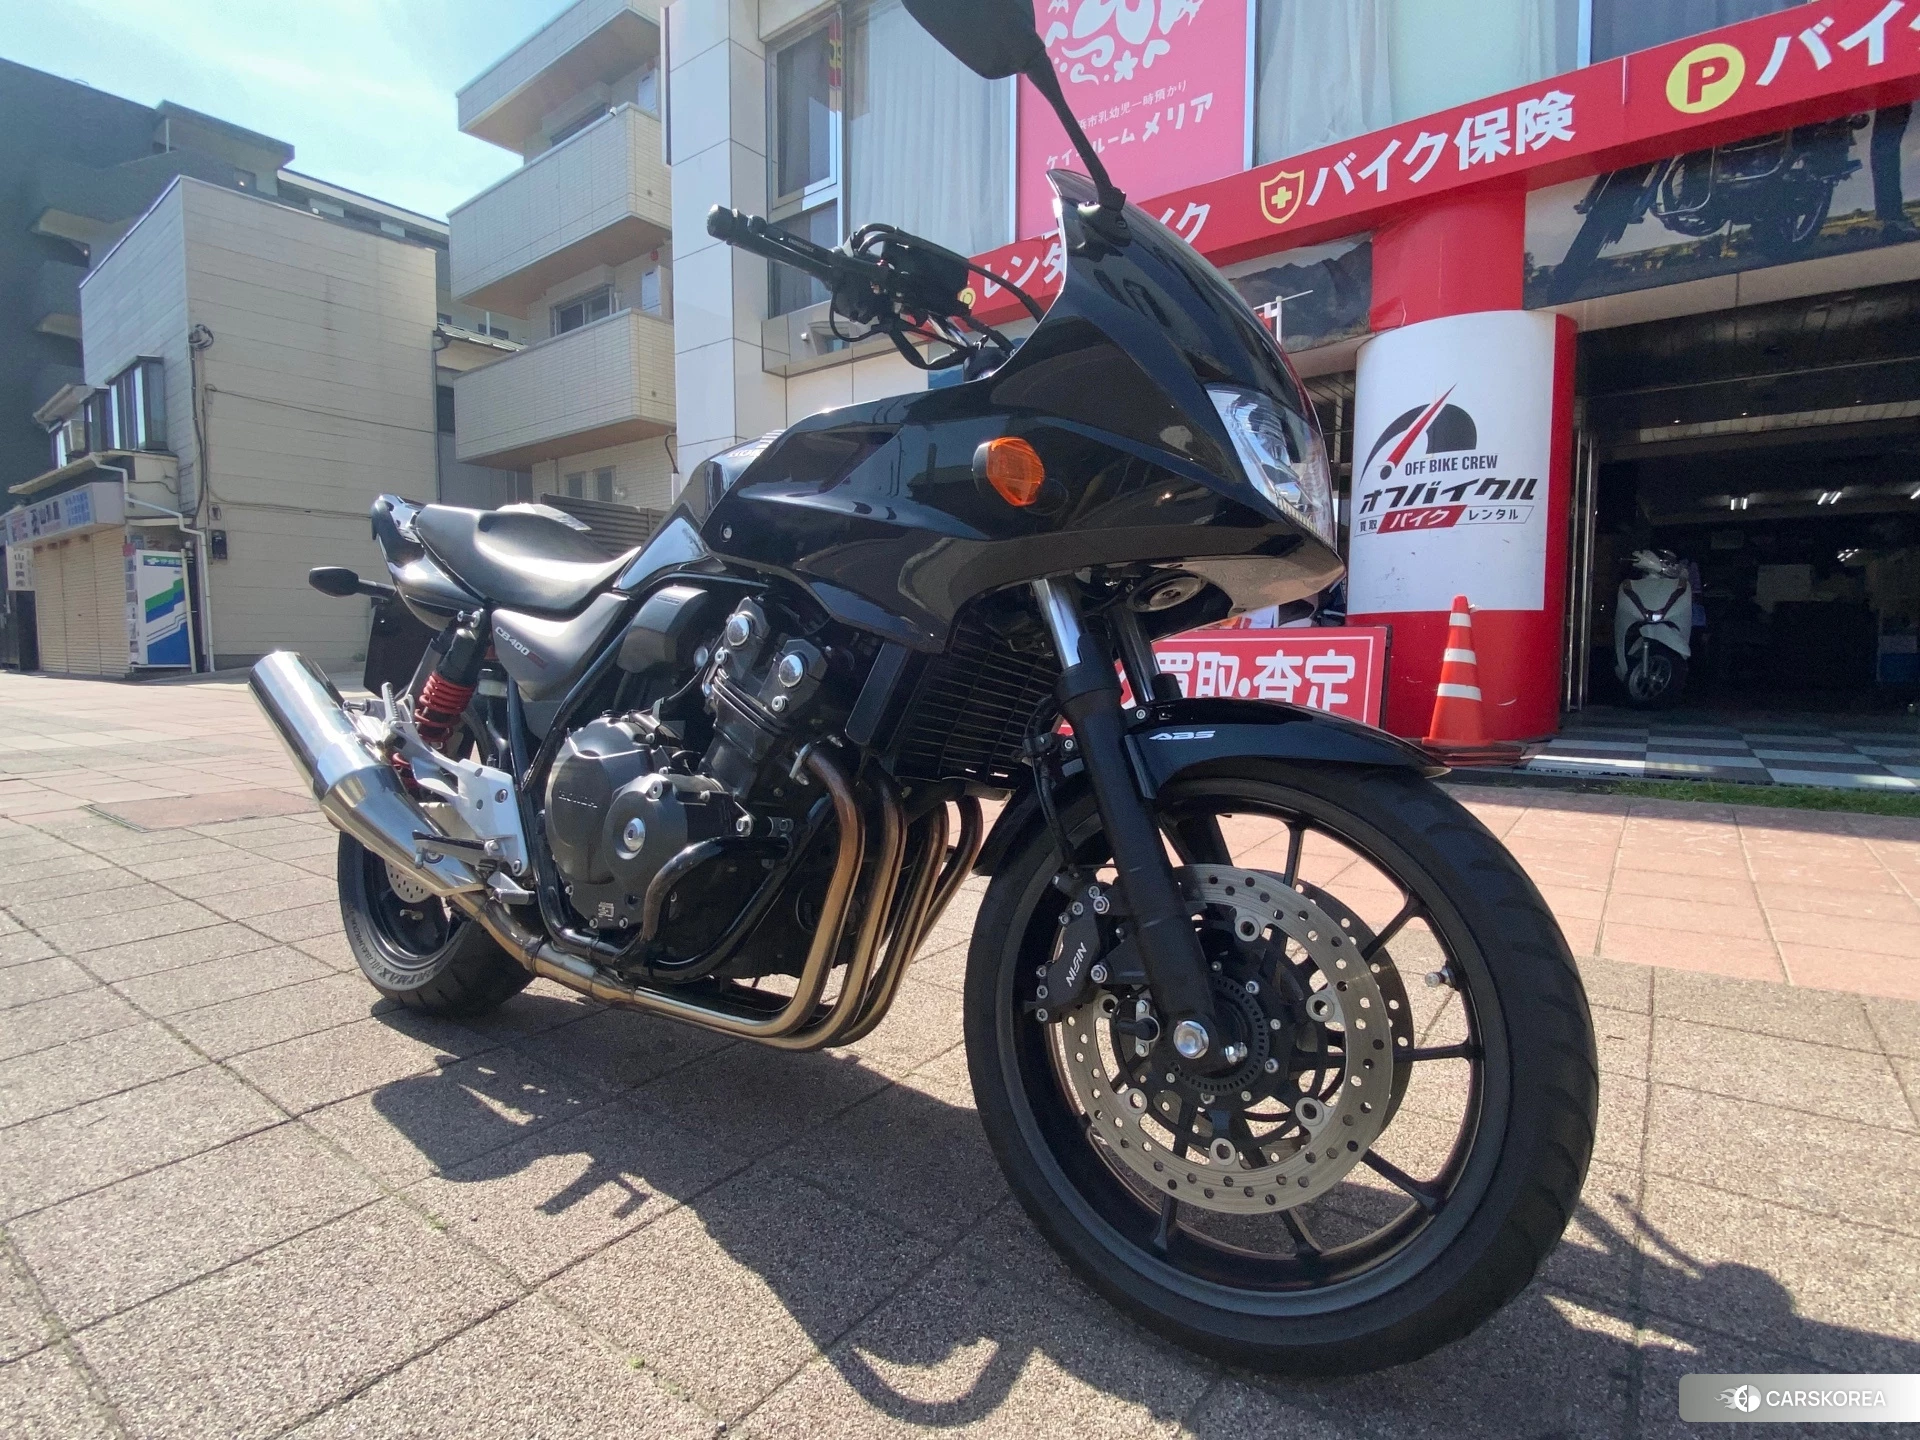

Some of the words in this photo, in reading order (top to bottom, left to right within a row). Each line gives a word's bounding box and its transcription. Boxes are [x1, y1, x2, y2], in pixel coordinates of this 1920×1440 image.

[1756, 0, 1920, 86] バイ
[1142, 92, 1213, 142] メリア
[1306, 90, 1576, 207] バイク保険
[1405, 461, 1425, 476] OFF
[1429, 458, 1458, 473] BIKE
[1462, 455, 1498, 470] CREW
[1360, 477, 1537, 515] オフバイクル
[1359, 519, 1378, 532] 買取
[1389, 509, 1449, 529] バイク
[1469, 507, 1518, 521] レンタル
[495, 626, 530, 656] CB400
[1148, 730, 1216, 741] ABS
[1065, 941, 1088, 988] NISSIN
